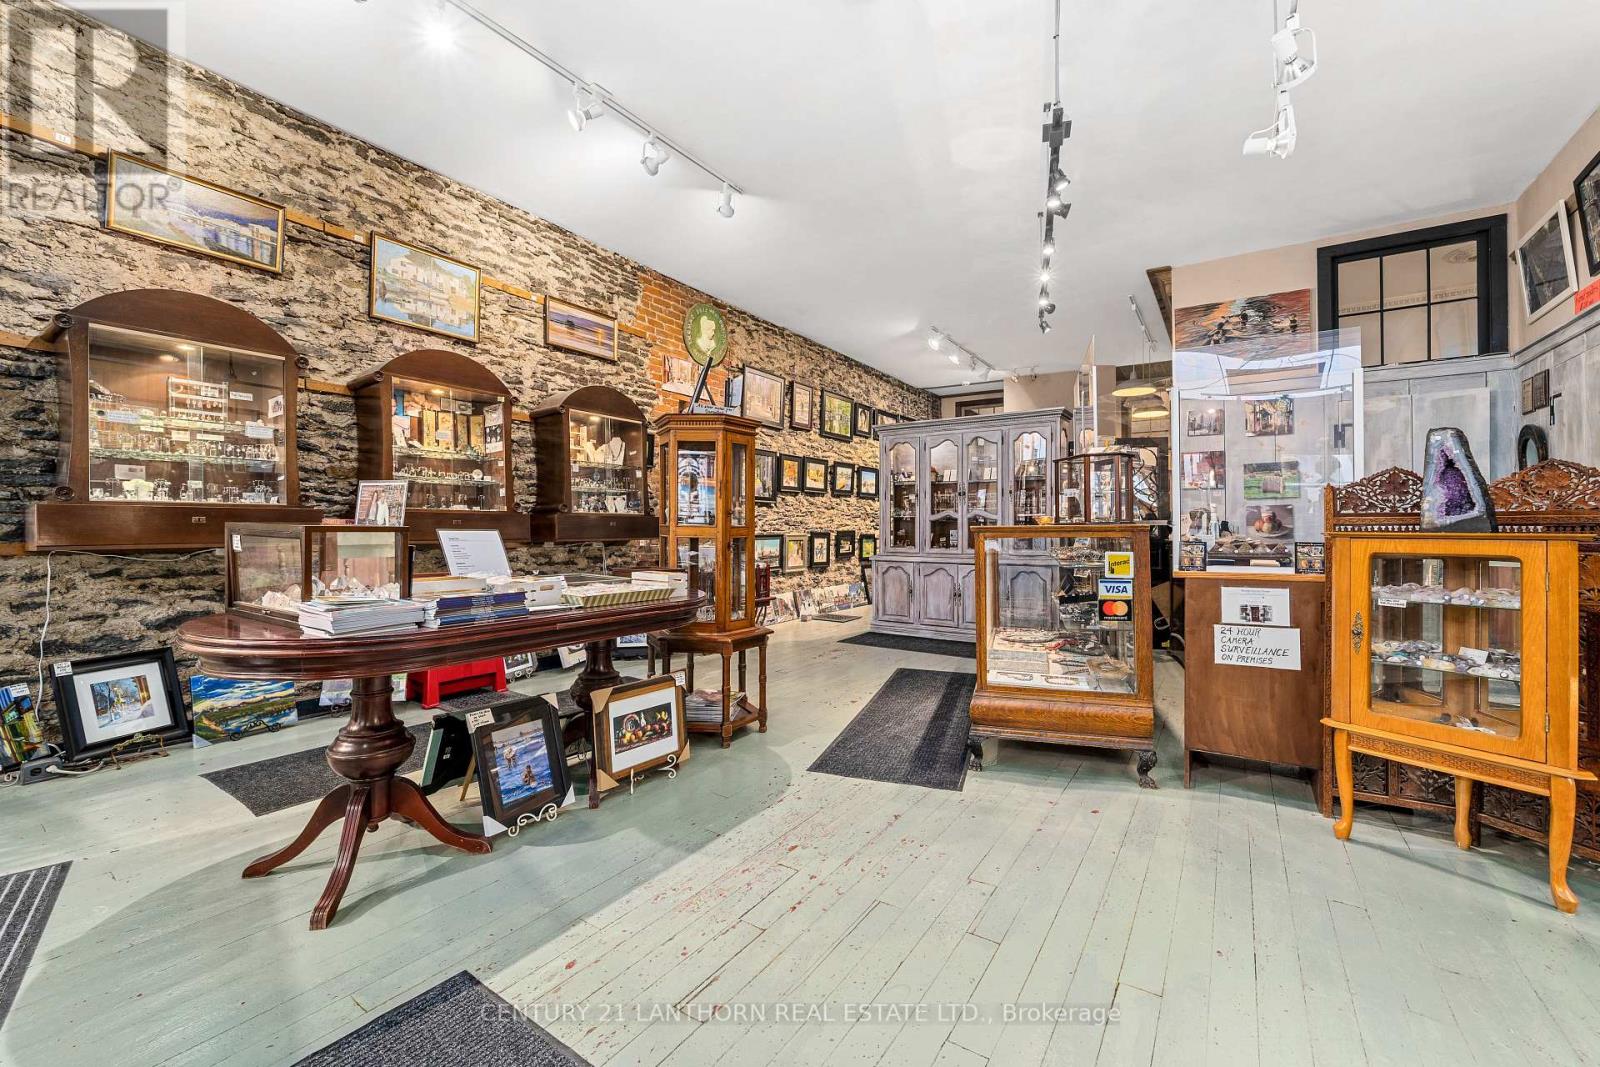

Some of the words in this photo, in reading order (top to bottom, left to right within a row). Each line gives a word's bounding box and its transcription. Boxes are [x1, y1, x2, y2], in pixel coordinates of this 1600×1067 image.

[1105, 585, 1128, 594] VISA
[1220, 626, 1233, 635] 24
[1236, 628, 1261, 637] HOUR
[1220, 636, 1254, 646] CAMERA
[1220, 645, 1289, 657] SURVEILLANCE
[1221, 653, 1233, 661] ON
[1236, 654, 1273, 665] PREMISES
